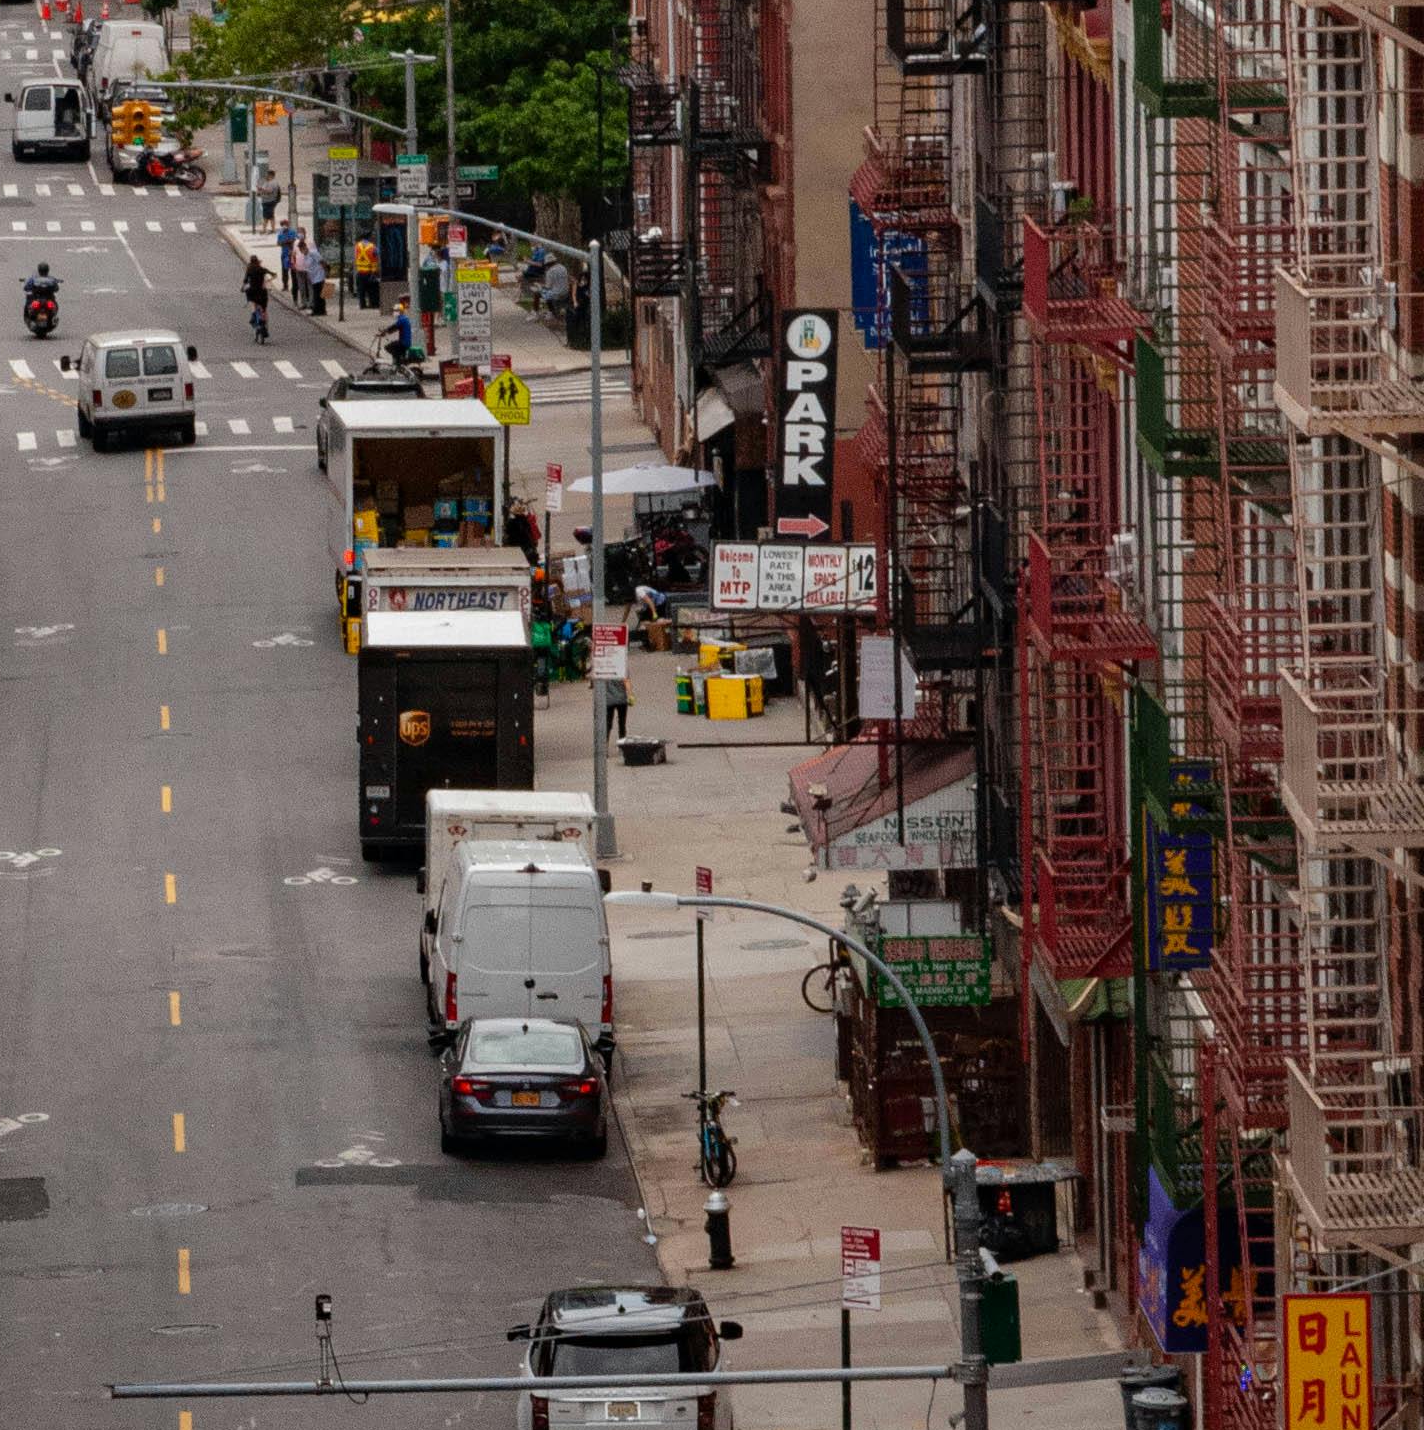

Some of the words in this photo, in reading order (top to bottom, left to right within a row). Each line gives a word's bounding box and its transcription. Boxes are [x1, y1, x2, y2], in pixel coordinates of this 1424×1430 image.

[331, 173, 356, 187] 20
[461, 299, 489, 315] 20
[493, 409, 526, 421] CHOOL
[783, 361, 828, 486] PARK
[763, 550, 800, 560] LOWEST
[808, 554, 843, 569] MONTHLY
[731, 566, 741, 578] To
[769, 562, 792, 570] RATE
[765, 573, 775, 581] IN
[777, 573, 796, 582] THIS
[720, 582, 751, 595] MTP
[768, 583, 792, 592] AREA
[414, 591, 509, 611] NORTHEAST
[403, 722, 428, 740] ups
[884, 816, 965, 829] NSSUN
